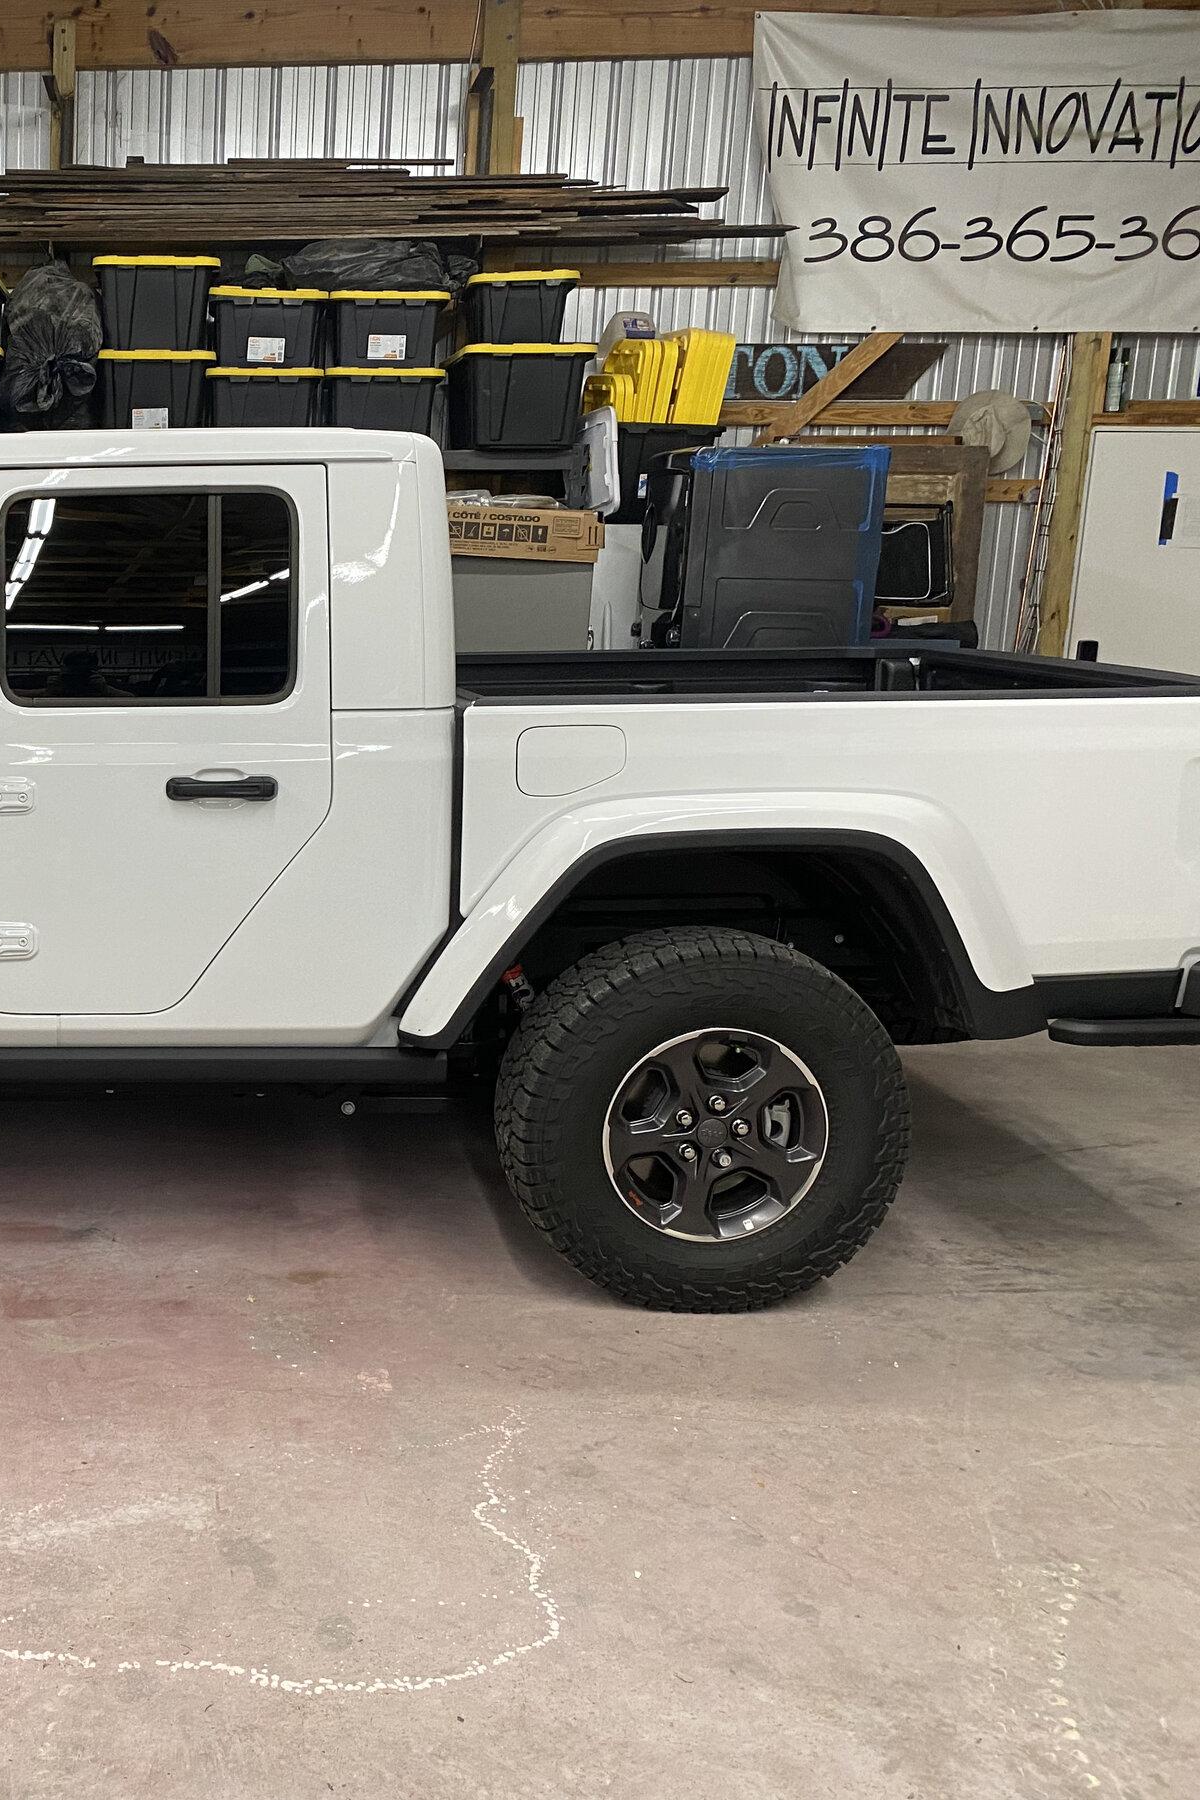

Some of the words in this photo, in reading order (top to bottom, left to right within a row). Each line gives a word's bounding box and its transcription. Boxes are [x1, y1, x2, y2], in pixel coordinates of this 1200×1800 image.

[767, 77, 956, 173] INFINITE
[803, 204, 1200, 263] 386-365-36
[452, 511, 481, 520] CÔTÉ
[489, 513, 541, 523] COSTADO
